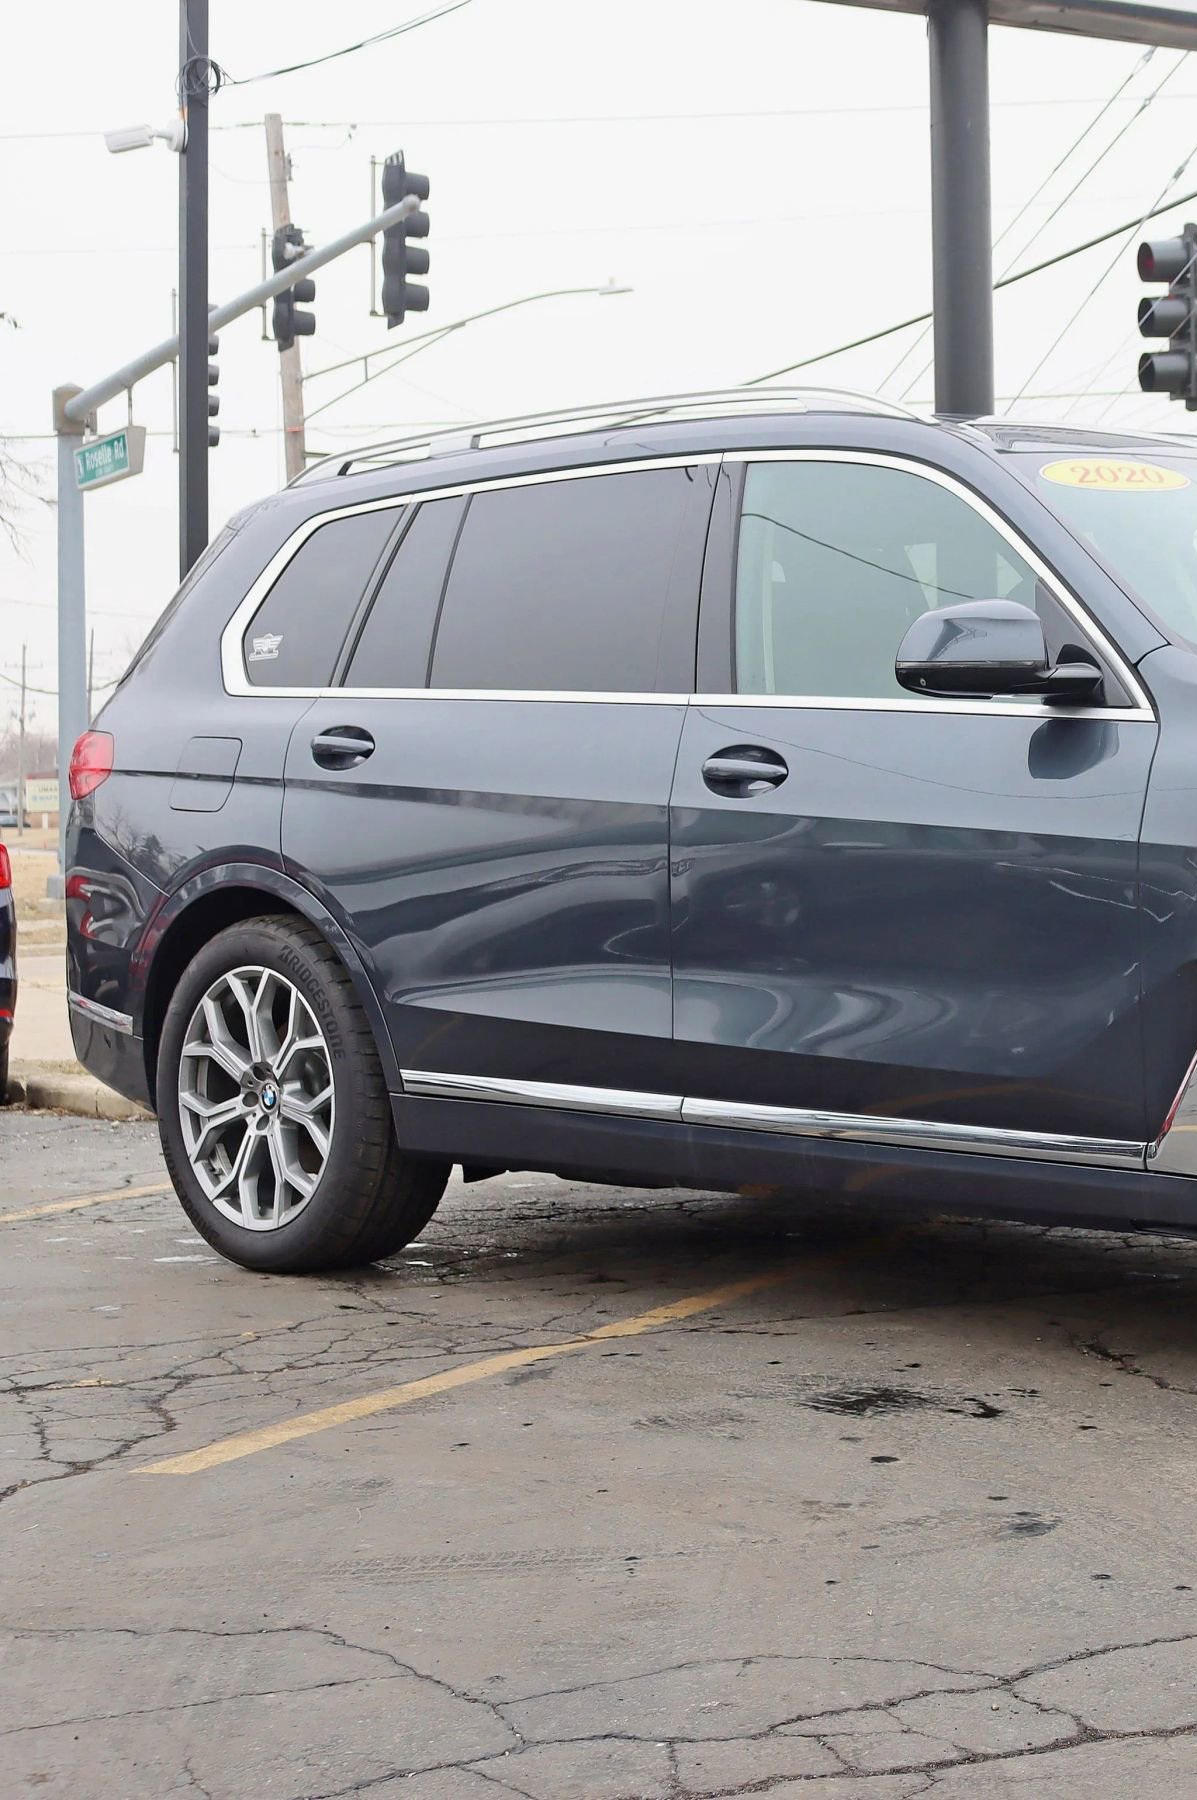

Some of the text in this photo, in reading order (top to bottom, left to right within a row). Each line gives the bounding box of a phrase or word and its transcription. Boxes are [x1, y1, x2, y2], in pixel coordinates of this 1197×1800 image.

[85, 443, 112, 472] Roselle
[114, 438, 124, 460] Rd
[1071, 466, 1164, 484] 2020
[277, 945, 345, 1060] BRIDGESTONE
